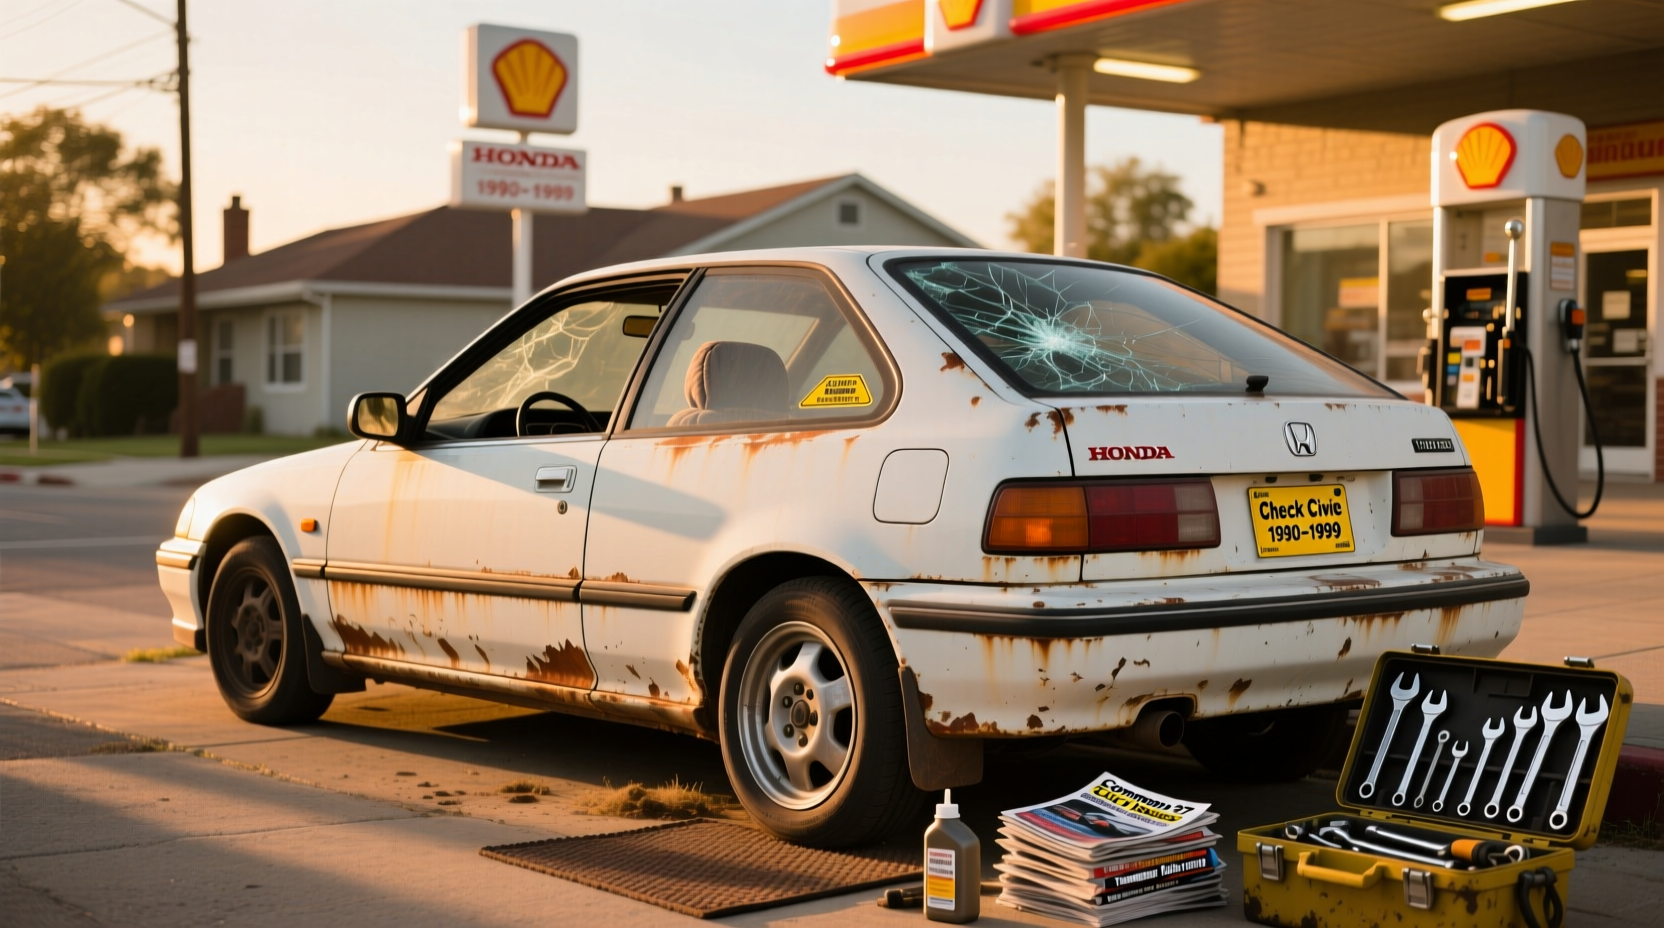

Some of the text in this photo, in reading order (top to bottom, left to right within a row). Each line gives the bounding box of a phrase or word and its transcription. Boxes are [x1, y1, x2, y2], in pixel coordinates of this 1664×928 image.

[472, 147, 581, 170] HONDA
[477, 179, 575, 202] 1990-1999
[1088, 446, 1175, 461] HONDA
[1260, 499, 1304, 520] Check
[1268, 521, 1341, 542] 1990-1999
